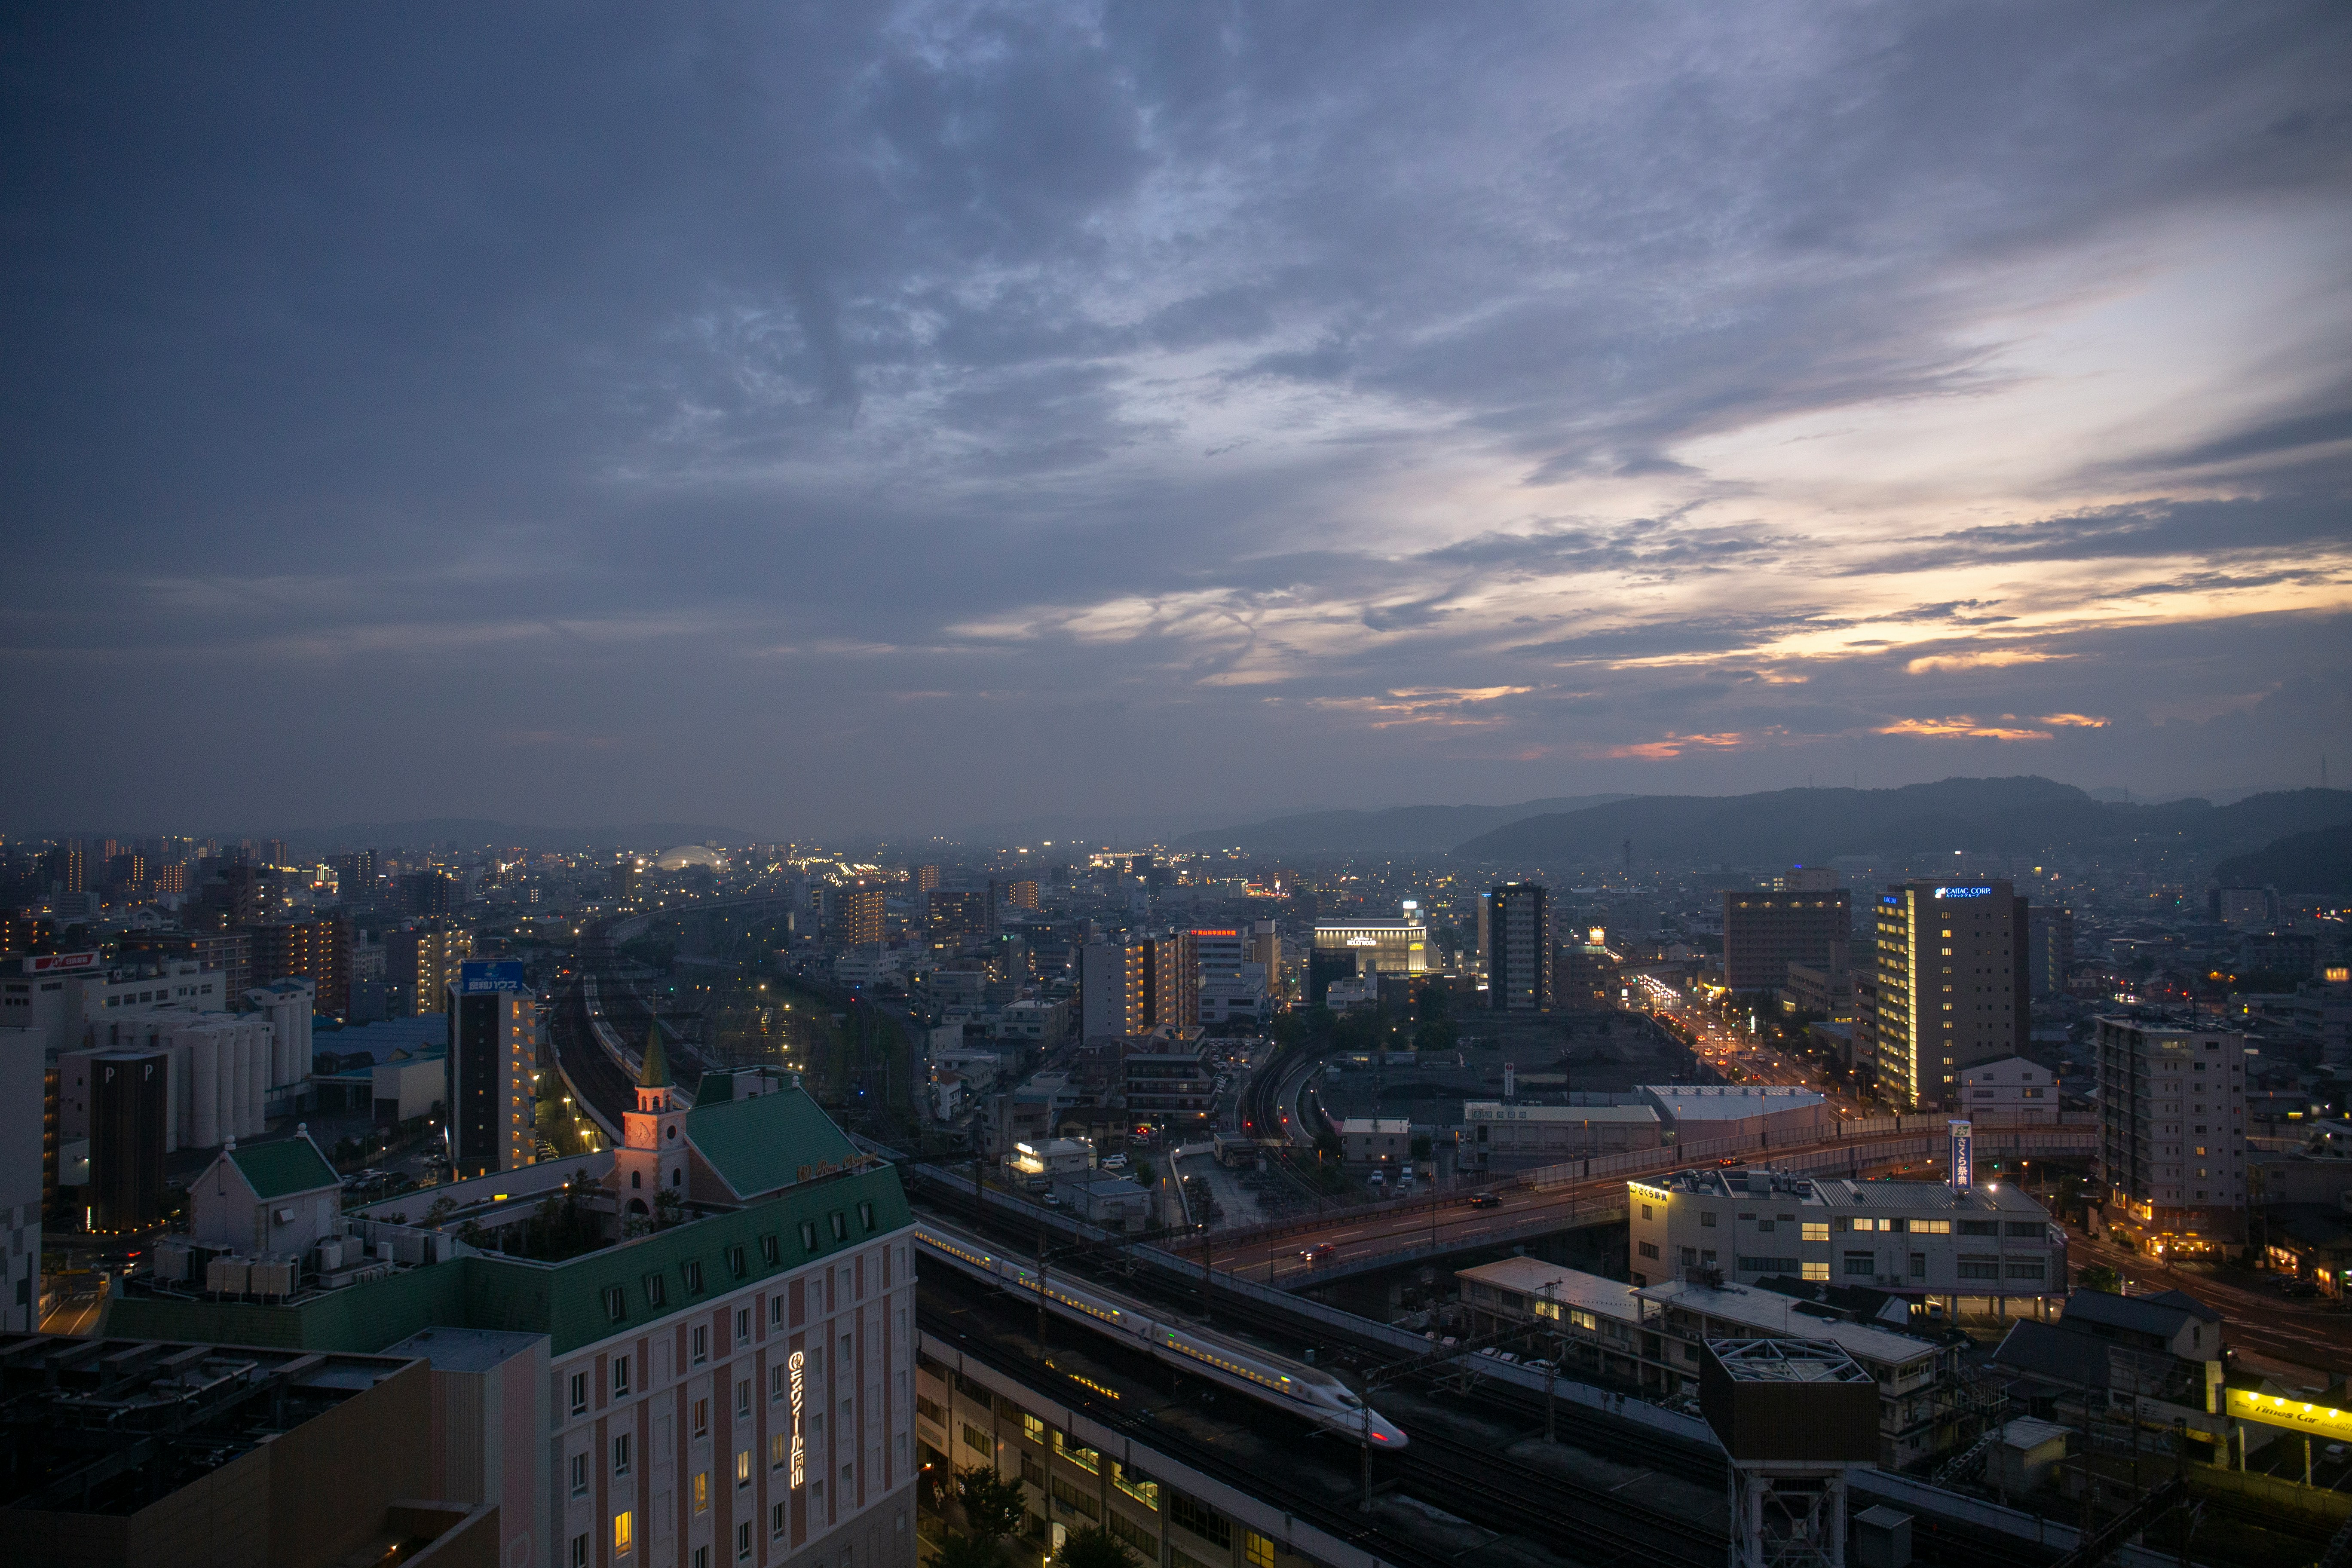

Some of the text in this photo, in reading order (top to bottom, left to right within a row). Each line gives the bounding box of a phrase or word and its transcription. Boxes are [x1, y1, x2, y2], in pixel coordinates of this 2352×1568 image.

[469, 981, 518, 990] 良和ハウス
[1957, 1137, 1968, 1185] さくら祭典
[1638, 1187, 1667, 1202] さくら祭典
[2256, 1404, 2294, 1419] Times
[2297, 1414, 2319, 1424] Car
